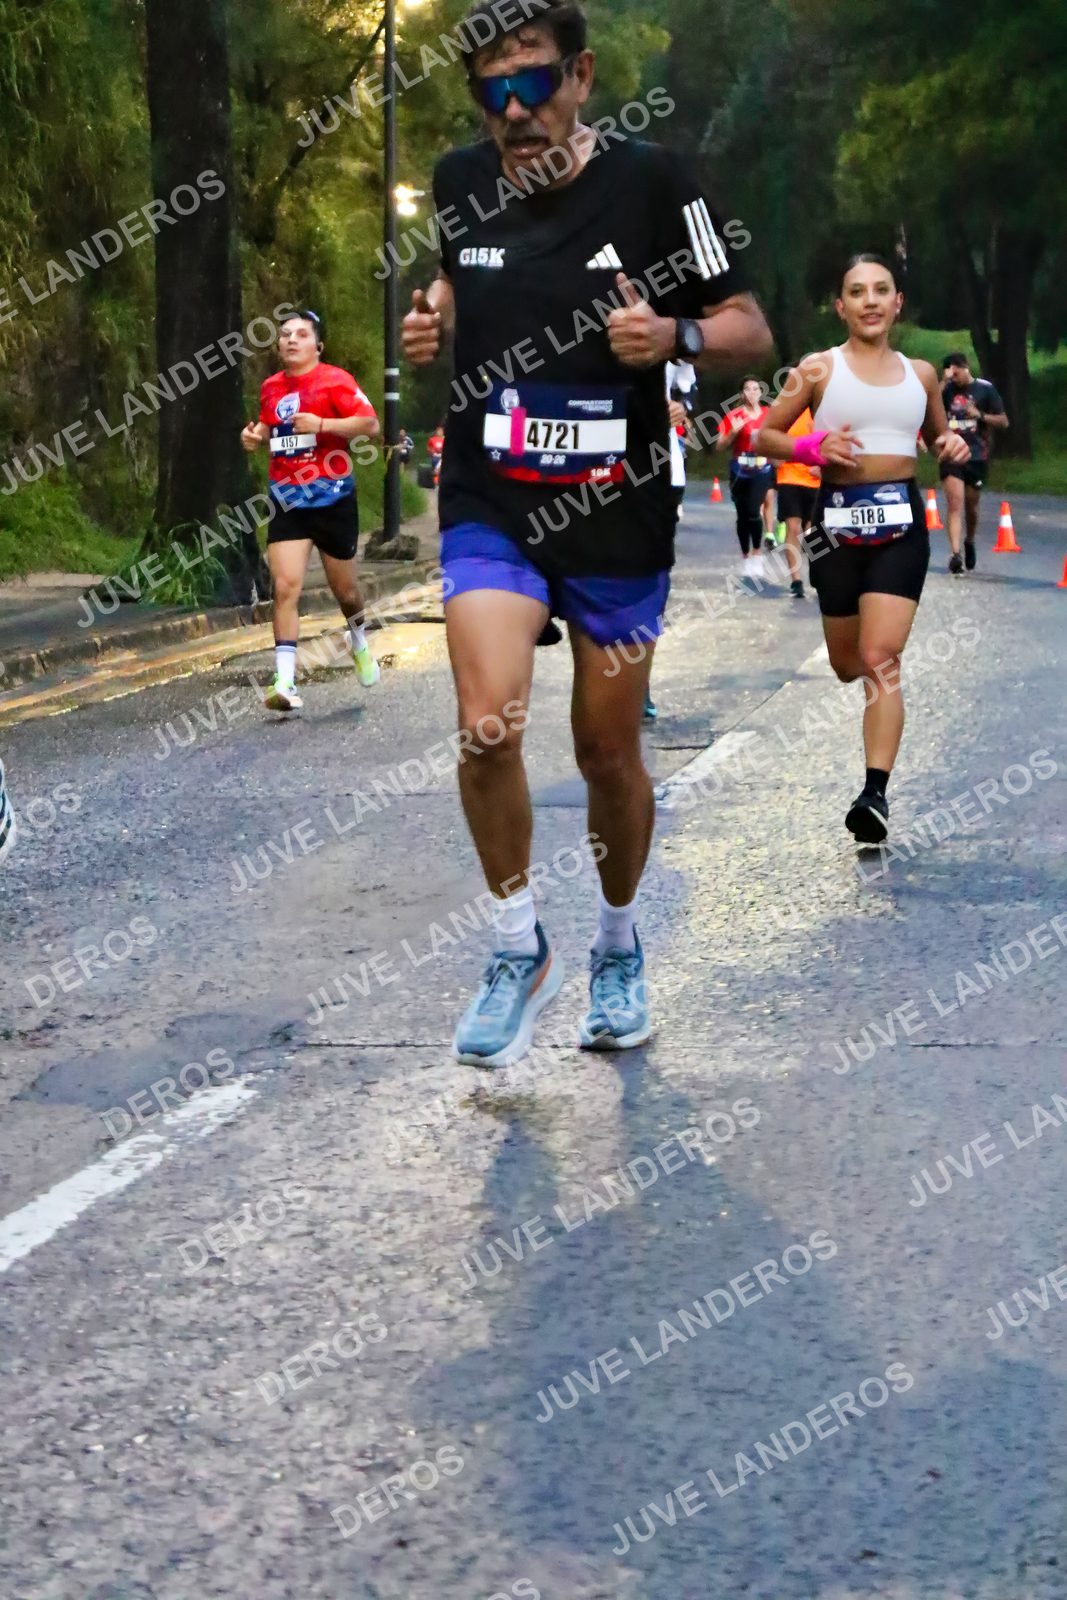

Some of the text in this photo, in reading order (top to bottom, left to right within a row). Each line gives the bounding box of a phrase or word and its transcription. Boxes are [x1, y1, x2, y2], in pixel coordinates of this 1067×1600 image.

[281, 437, 298, 448] 4157
[527, 421, 580, 450] 4721
[851, 508, 885, 525] 5188
